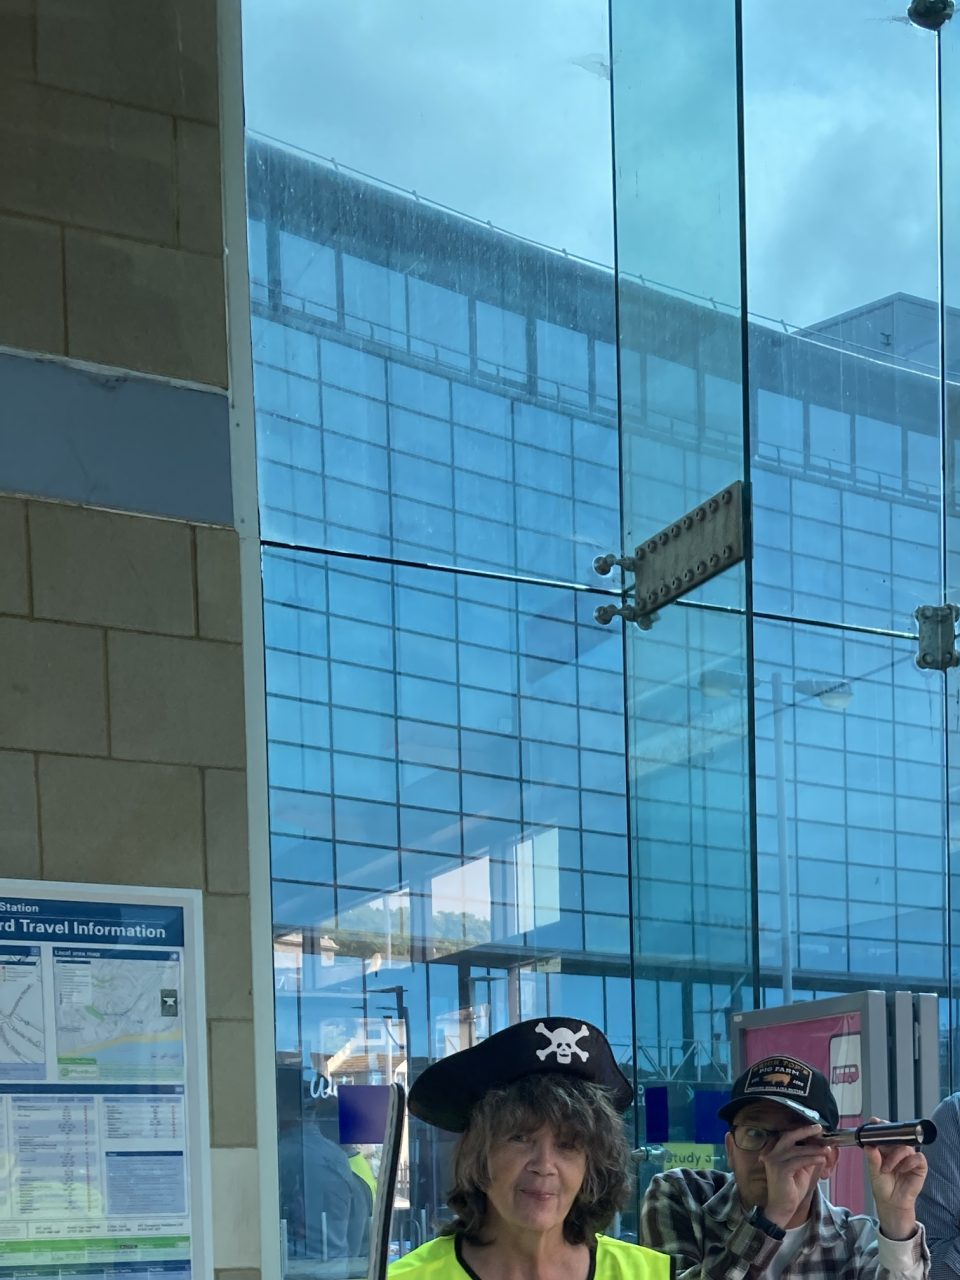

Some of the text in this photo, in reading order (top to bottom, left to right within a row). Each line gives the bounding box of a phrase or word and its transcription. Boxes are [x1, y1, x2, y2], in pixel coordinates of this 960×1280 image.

[0, 902, 39, 913] Station
[19, 919, 69, 934] Travel
[74, 921, 166, 938] Information
[774, 1066, 800, 1076] FARM
